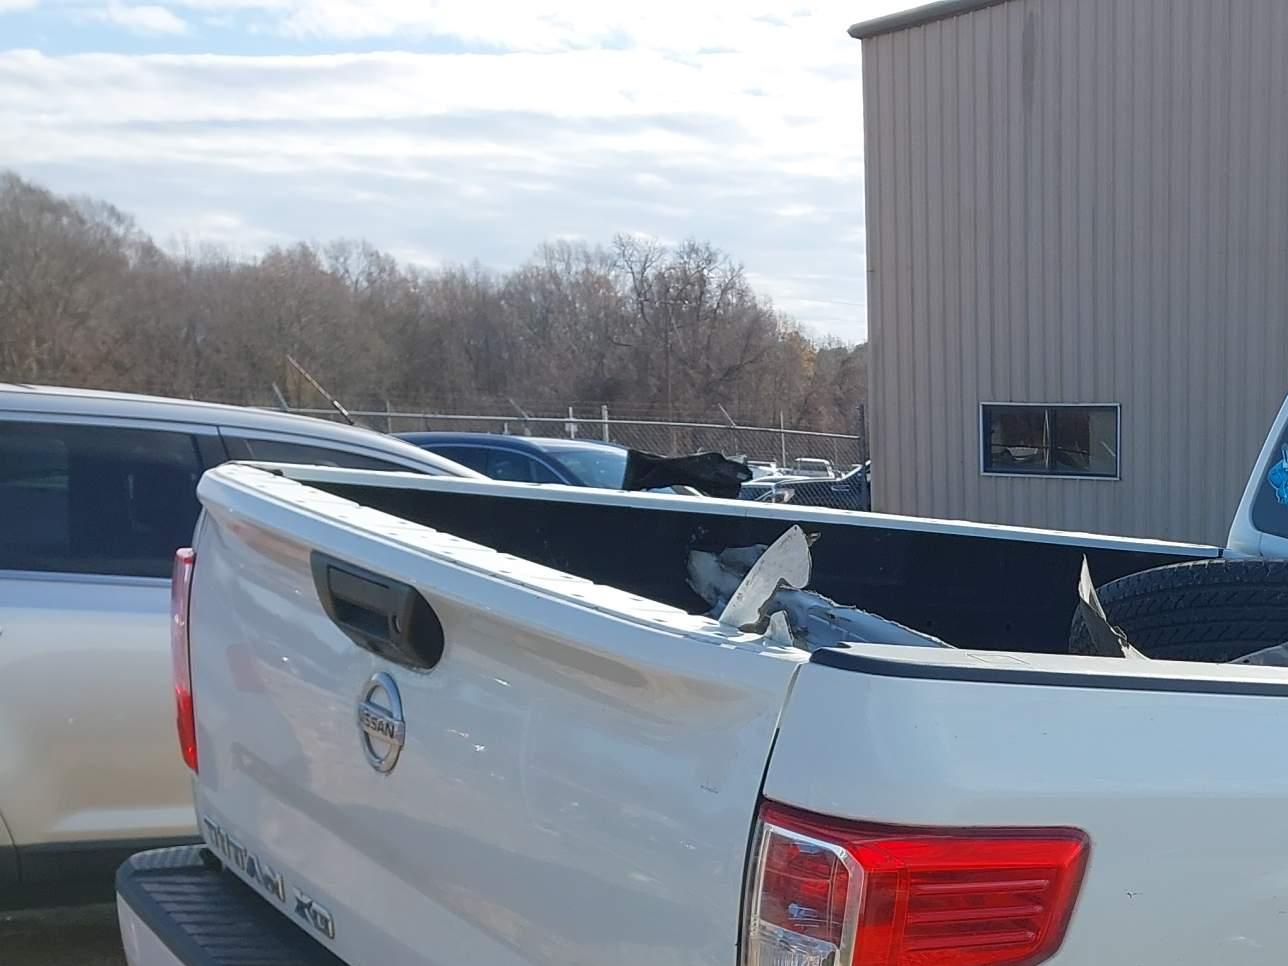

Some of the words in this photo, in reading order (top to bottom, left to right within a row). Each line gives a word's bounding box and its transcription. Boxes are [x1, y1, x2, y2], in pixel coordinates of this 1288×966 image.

[360, 706, 396, 740] SSAN
[203, 815, 286, 903] TITAN
[293, 886, 336, 940] XD
